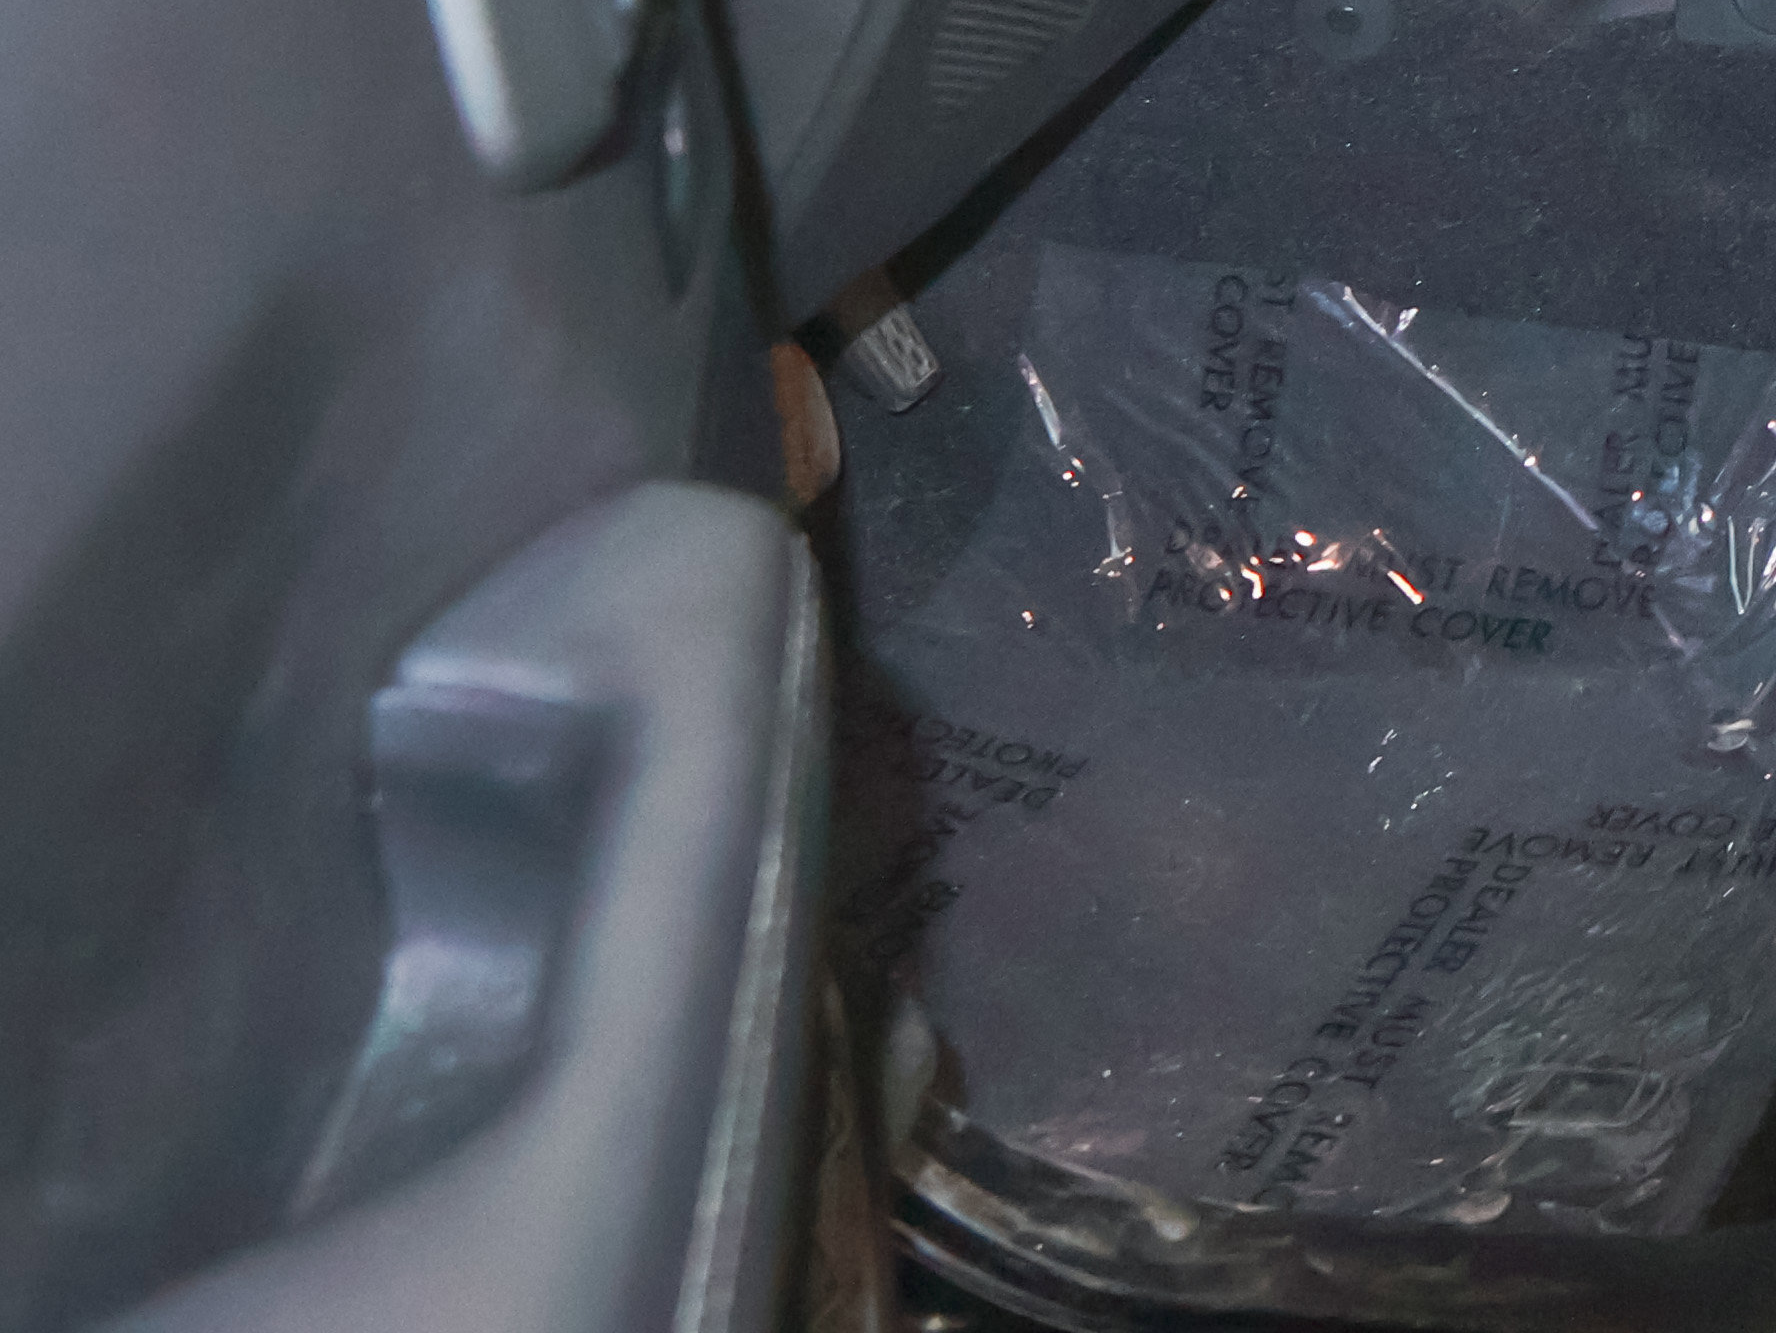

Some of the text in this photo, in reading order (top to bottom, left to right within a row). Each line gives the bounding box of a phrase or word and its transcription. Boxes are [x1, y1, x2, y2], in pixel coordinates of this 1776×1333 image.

[1199, 273, 1250, 411] COVER
[1409, 604, 1554, 656] COVER
[1486, 561, 1658, 620] REMOVE
[1465, 824, 1656, 870] REMOVE
[1585, 803, 1738, 843] COVER
[1421, 861, 1534, 976] DEALER
[1215, 854, 1468, 1174] PROTECTIVE COVER
[1342, 992, 1442, 1093] MUST
